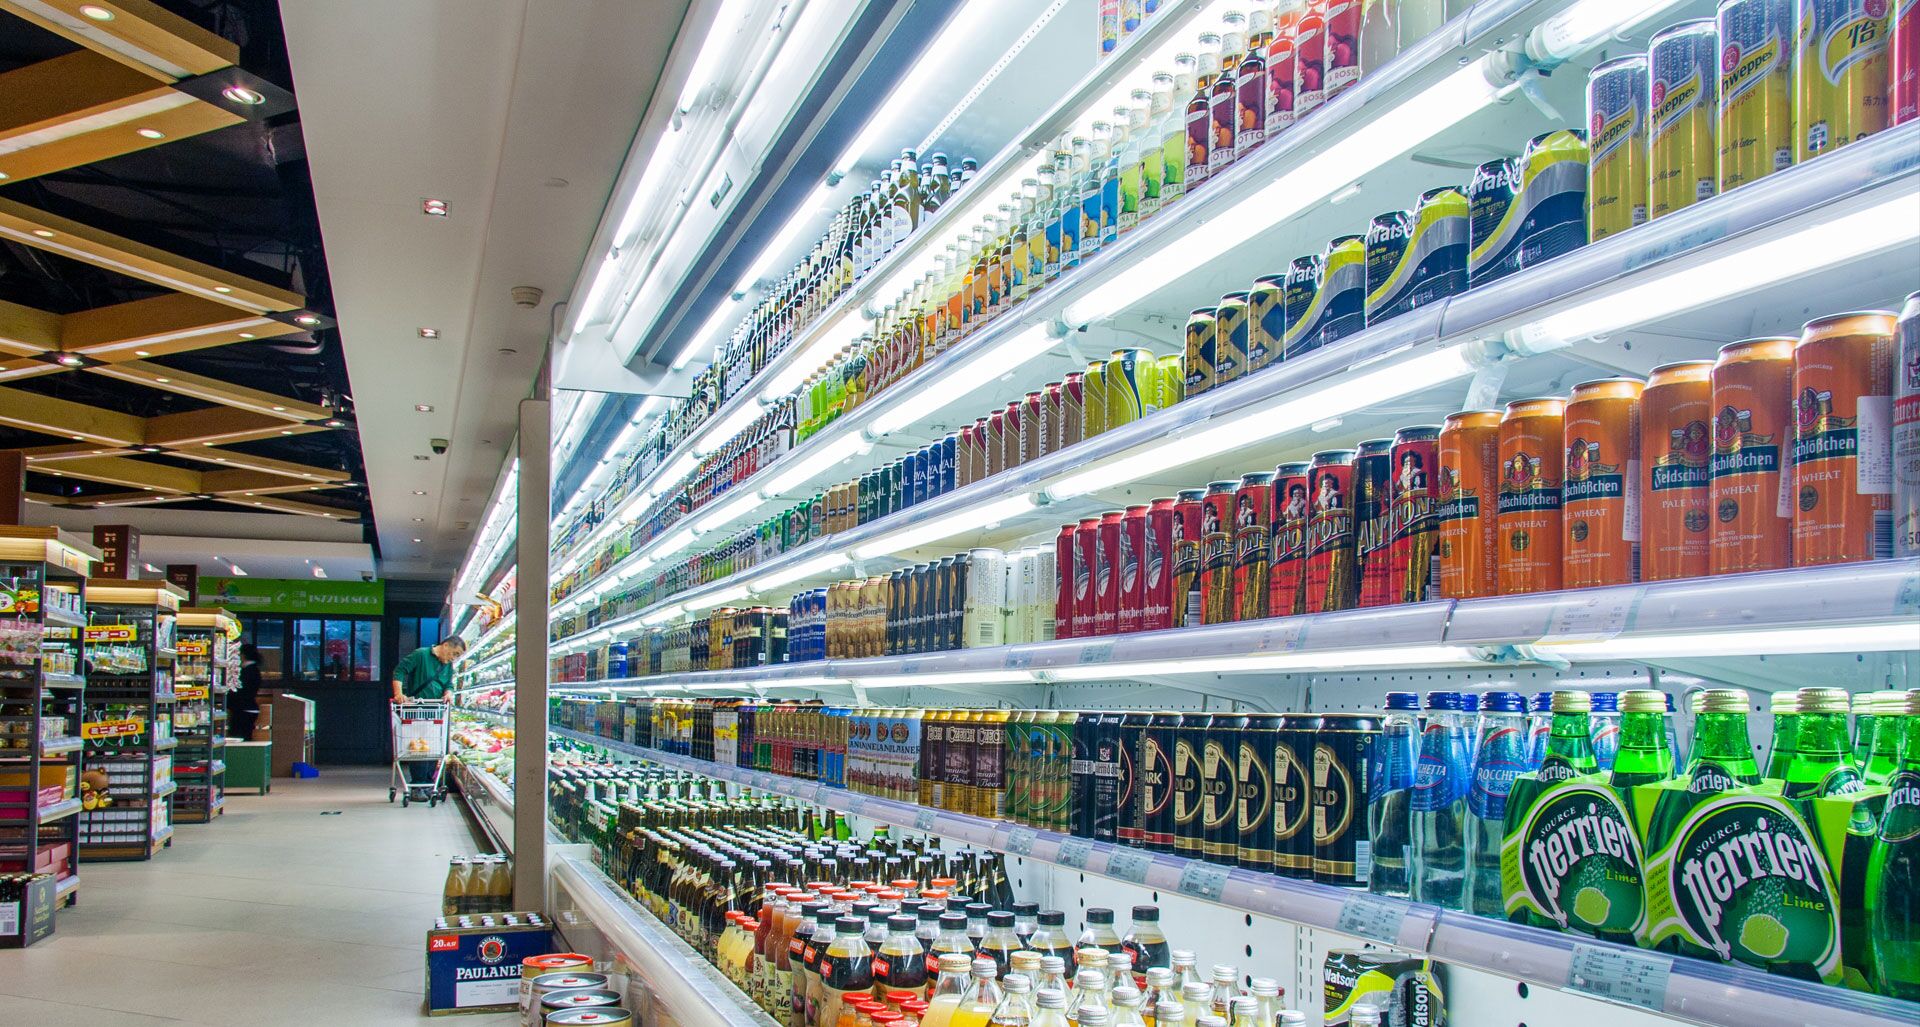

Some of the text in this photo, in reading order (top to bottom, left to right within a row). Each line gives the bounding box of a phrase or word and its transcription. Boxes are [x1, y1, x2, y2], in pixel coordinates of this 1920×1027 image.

[1654, 468, 1708, 489] Feldschlö
[1801, 470, 1841, 482] WHEAT
[1721, 484, 1760, 496] WHEAT
[1574, 508, 1608, 518] WHEAT
[1515, 520, 1547, 529] WHEAT
[1541, 806, 1577, 837] SOURCE
[1696, 820, 1742, 857] SOURCE
[1529, 803, 1636, 929] perrier
[1605, 869, 1638, 884] Lime
[1682, 817, 1821, 961] perrier
[1782, 893, 1826, 911] Lime
